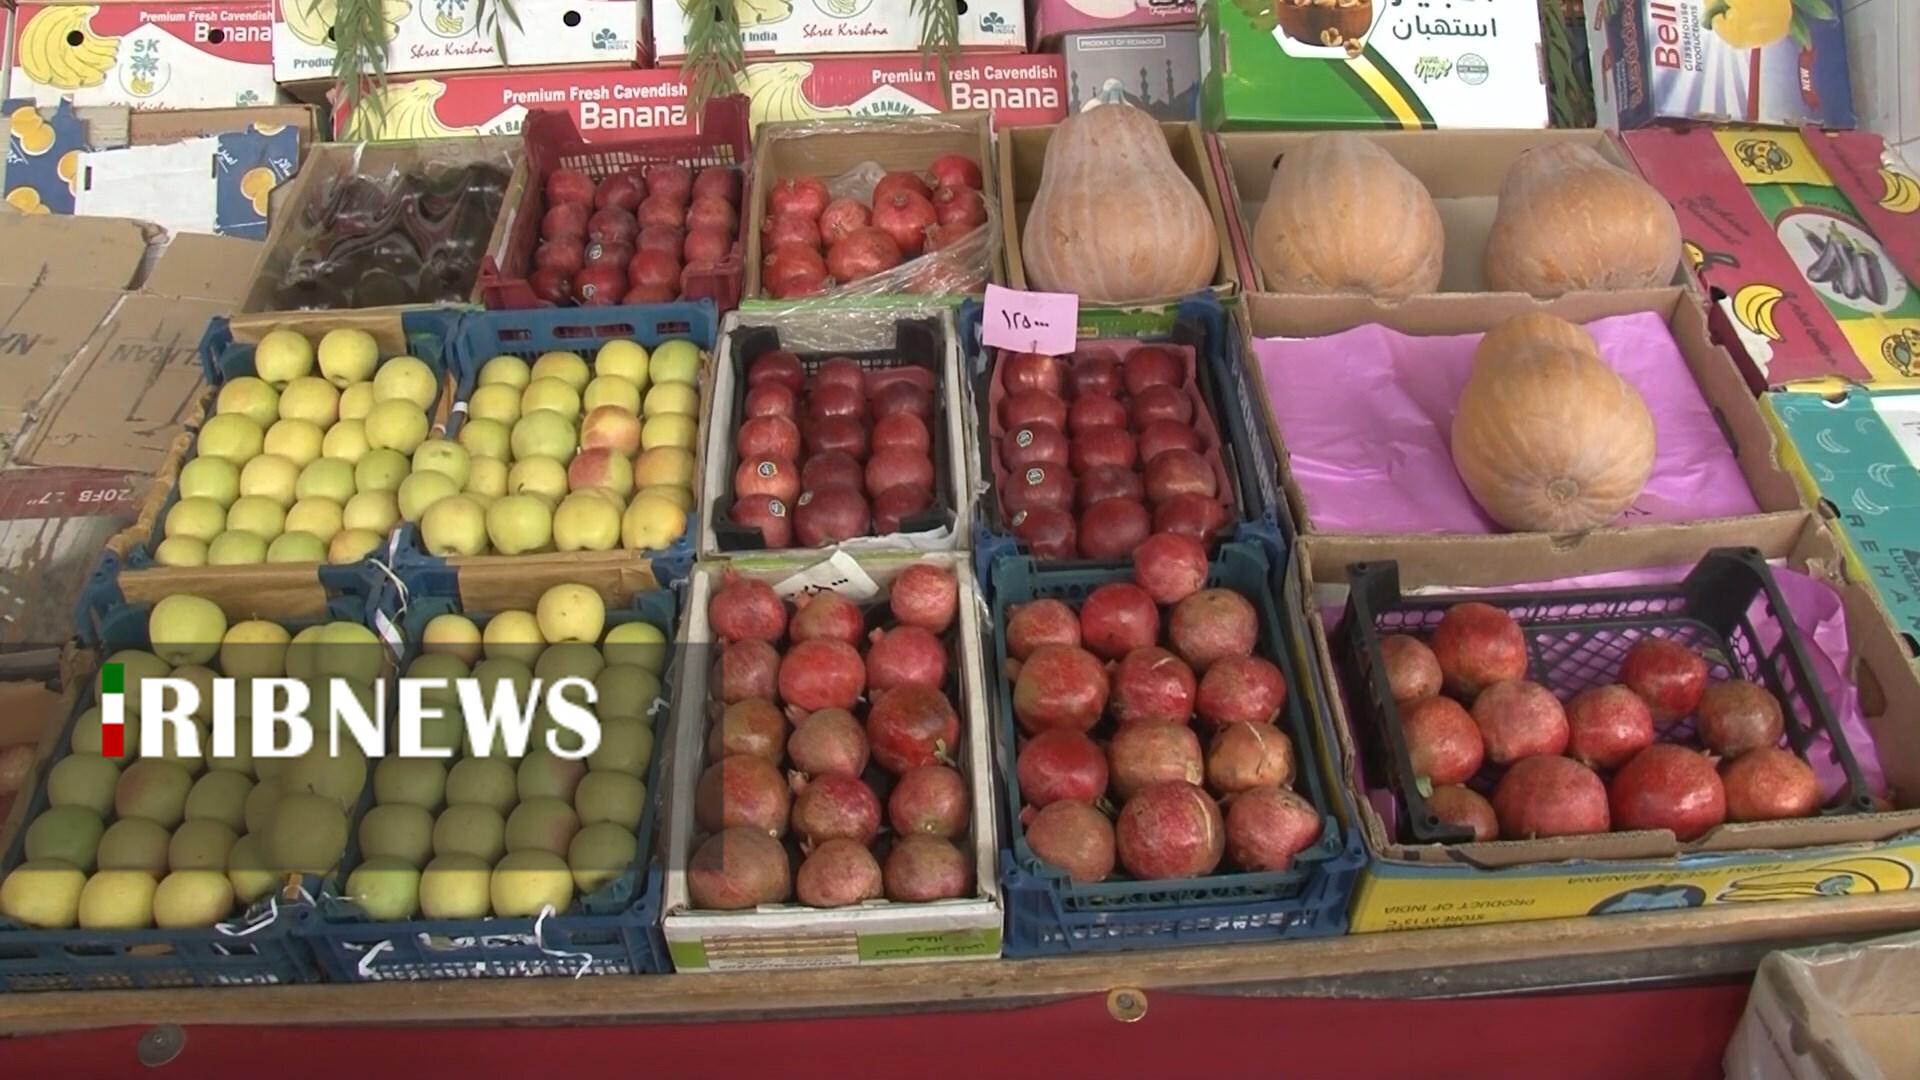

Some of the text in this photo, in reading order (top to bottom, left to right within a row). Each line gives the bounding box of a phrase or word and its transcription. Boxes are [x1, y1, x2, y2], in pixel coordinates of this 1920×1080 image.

[140, 11, 273, 22] Premium Fresh Cavendish
[194, 23, 271, 42] Bnana
[748, 32, 778, 42] India
[803, 23, 888, 39] Shree Krishna
[1393, 15, 1497, 40] استهبان
[1652, 3, 1681, 71] Bell
[1681, 2, 1694, 71] GlassHouse
[134, 39, 160, 53] SK
[1694, 5, 1703, 72] Productions
[410, 43, 495, 60] Shree Krishna
[293, 57, 336, 69] Produc
[872, 63, 1058, 84] Premium resh Cavendish
[503, 82, 688, 104] Premium Fresh Cavendish
[951, 82, 1058, 110] Banana
[580, 102, 688, 130] Banana
[871, 100, 916, 116] BANANA
[1384, 899, 1536, 914] PRODUCT OF INDIA
